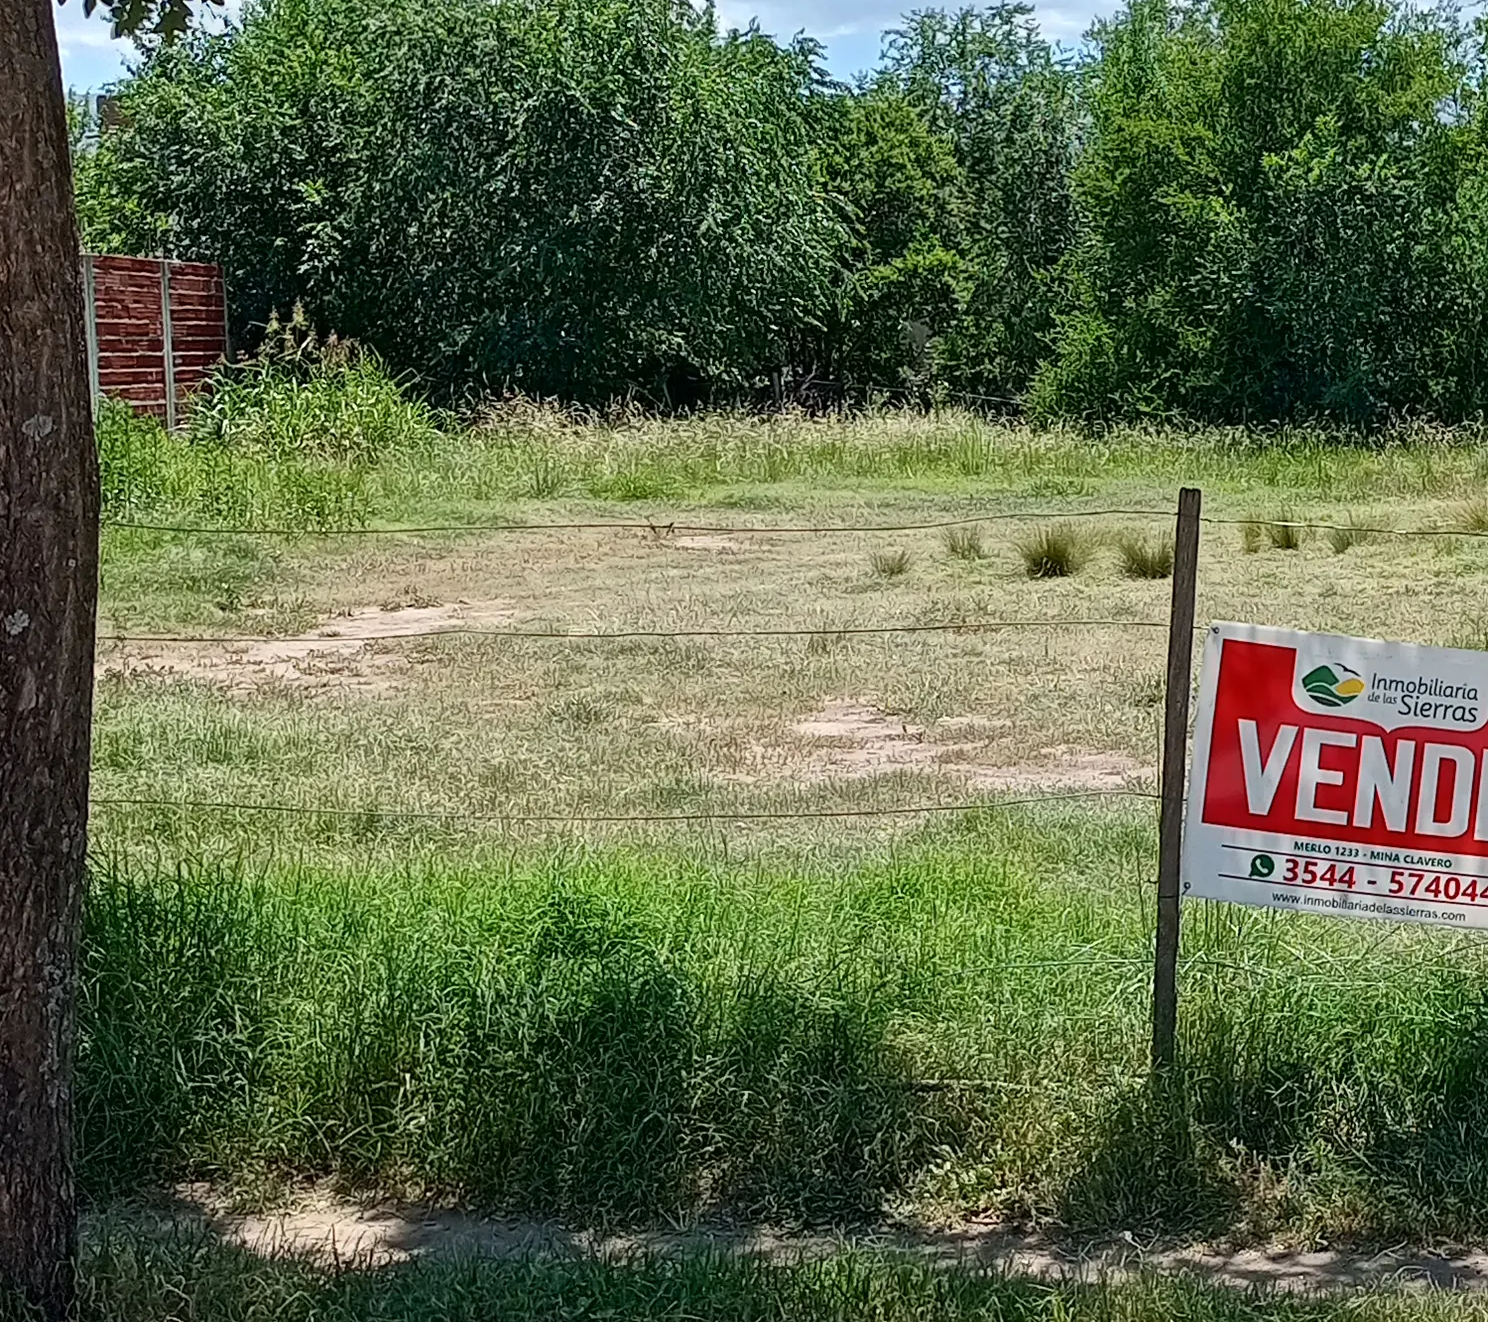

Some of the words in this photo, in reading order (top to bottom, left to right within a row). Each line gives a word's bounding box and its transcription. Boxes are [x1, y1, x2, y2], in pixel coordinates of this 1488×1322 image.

[1371, 673, 1478, 701] Inmobiliaria
[1367, 692, 1380, 703] de
[1383, 693, 1397, 704] las
[1398, 694, 1478, 723] Sierras
[1293, 841, 1331, 855] MERLO
[1335, 845, 1360, 858] 1233
[1369, 850, 1400, 863] MINA
[1403, 854, 1452, 868] CLAVERO
[1283, 858, 1356, 889] 3544
[1271, 891, 1466, 922] www.inmobiliariadelassierras.com
